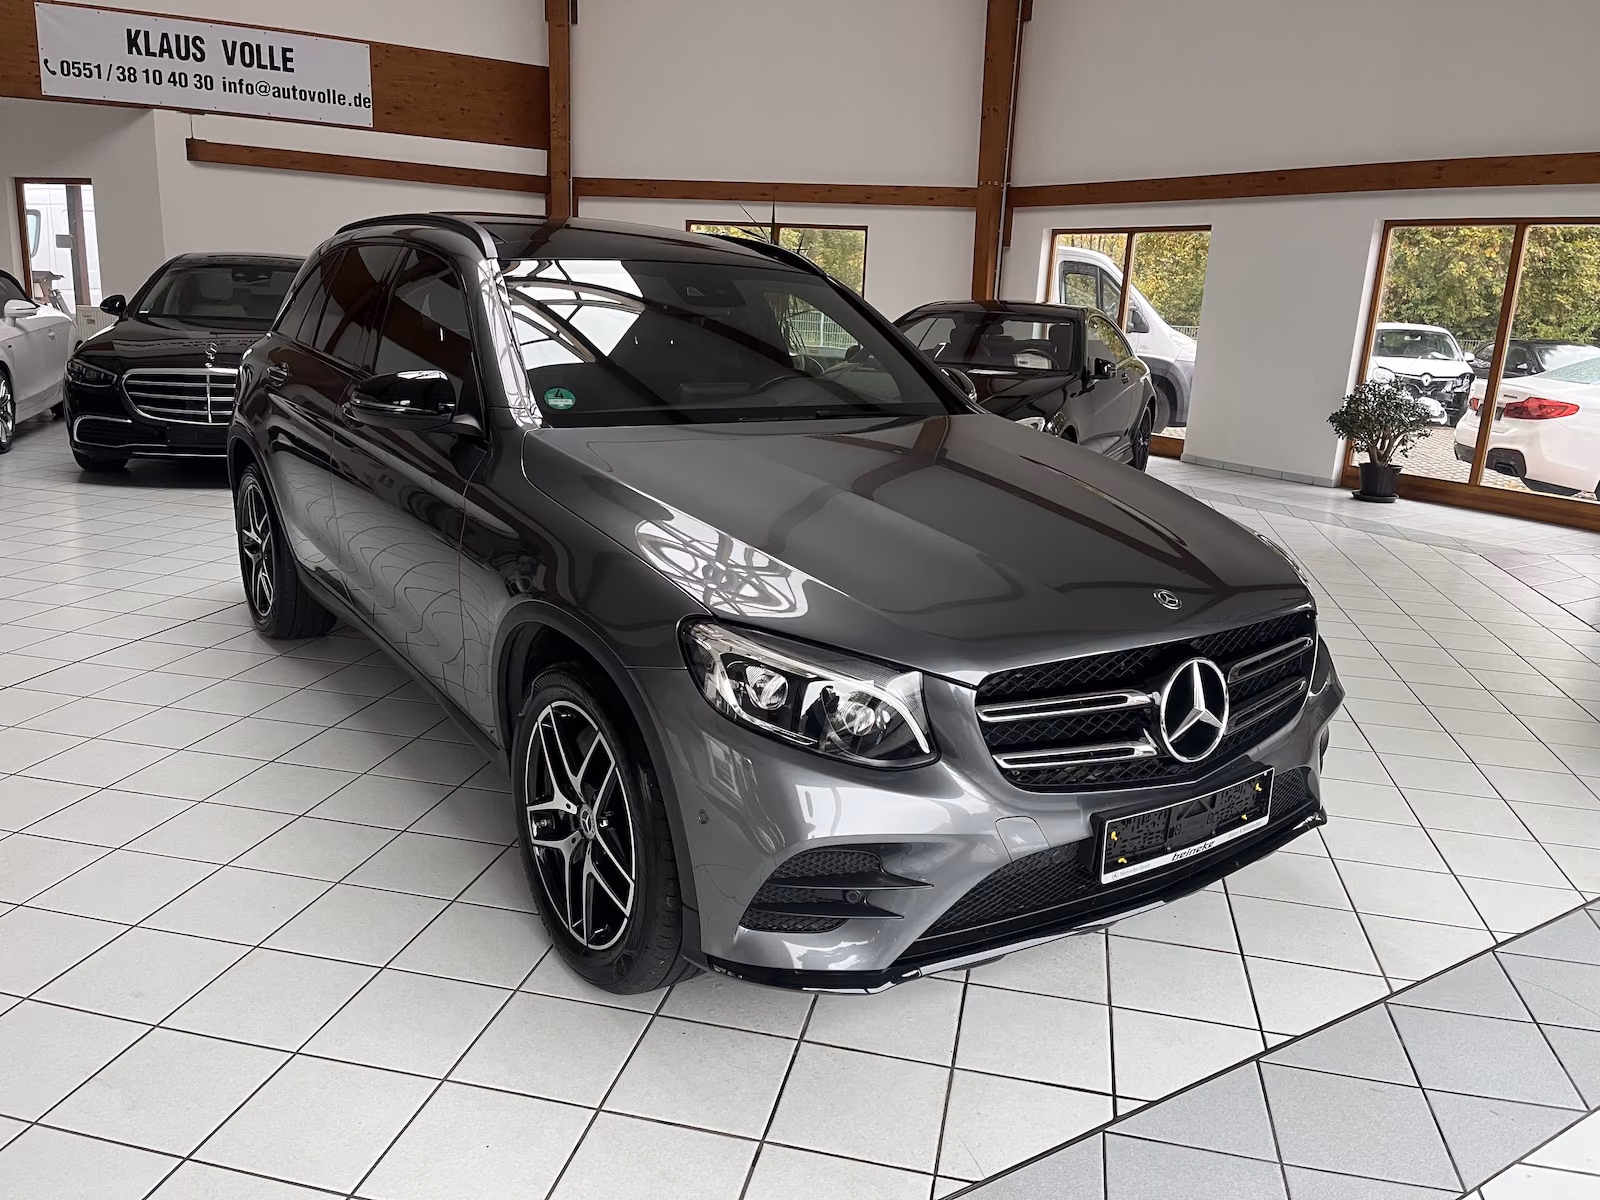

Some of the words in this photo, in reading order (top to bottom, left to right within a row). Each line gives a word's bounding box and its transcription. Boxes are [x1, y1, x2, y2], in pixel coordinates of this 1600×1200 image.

[125, 28, 206, 63] KLAUS
[221, 39, 295, 74] VOLLE
[141, 68, 163, 86] 10
[167, 71, 189, 88] 40
[192, 73, 214, 91] 30
[222, 76, 372, 109] info@autovolle.de
[554, 389, 564, 399] 4
